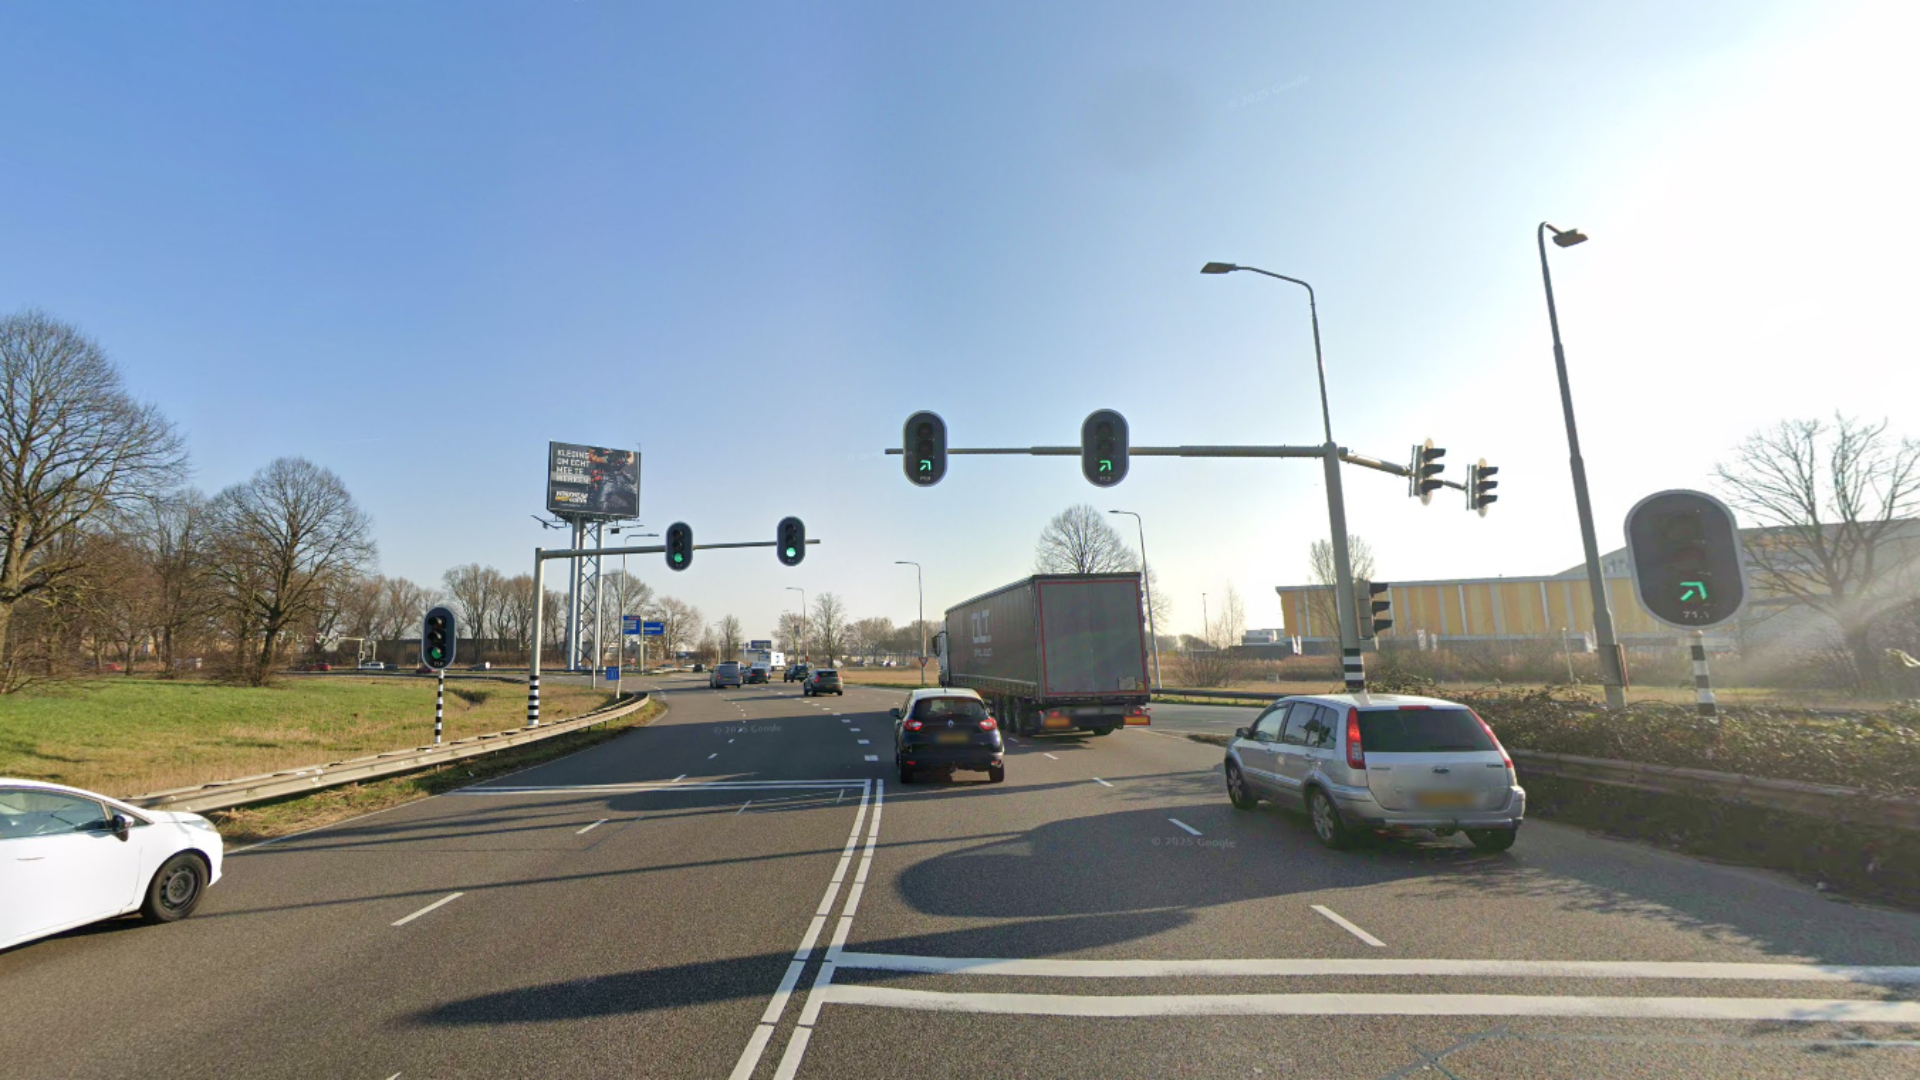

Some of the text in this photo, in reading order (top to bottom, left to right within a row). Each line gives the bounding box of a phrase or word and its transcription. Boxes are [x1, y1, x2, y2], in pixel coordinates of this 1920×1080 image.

[557, 449, 590, 459] KLEDING
[556, 466, 584, 476] MEE TE
